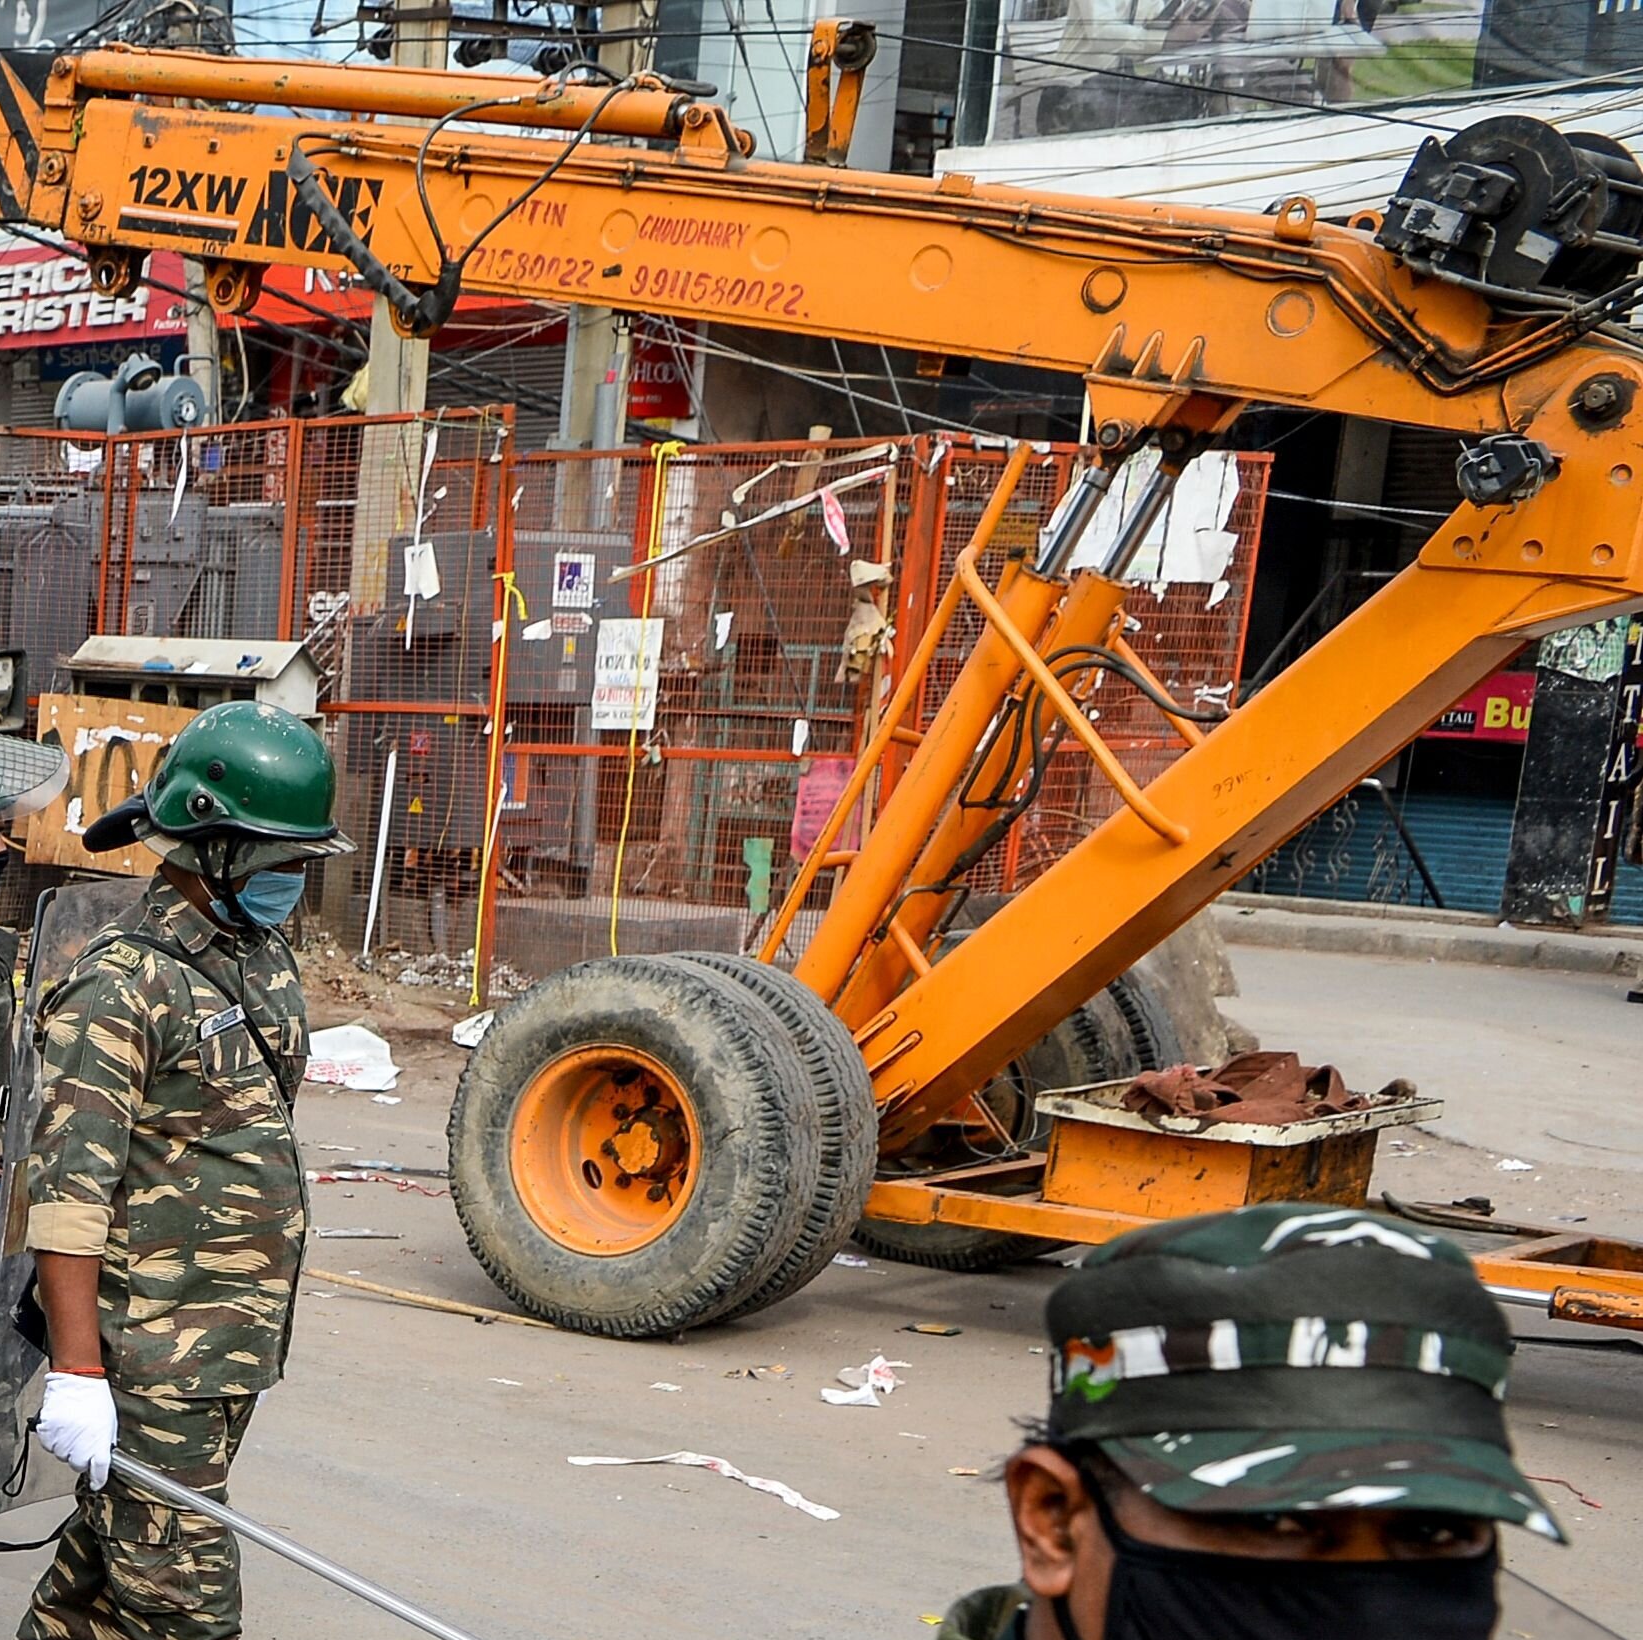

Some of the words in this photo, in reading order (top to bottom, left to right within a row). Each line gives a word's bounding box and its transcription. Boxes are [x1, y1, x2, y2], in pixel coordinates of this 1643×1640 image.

[128, 165, 248, 214] 12XW
[244, 169, 384, 255] ACE
[638, 214, 751, 250] CHOUDHARY
[59, 340, 162, 367] Samsote
